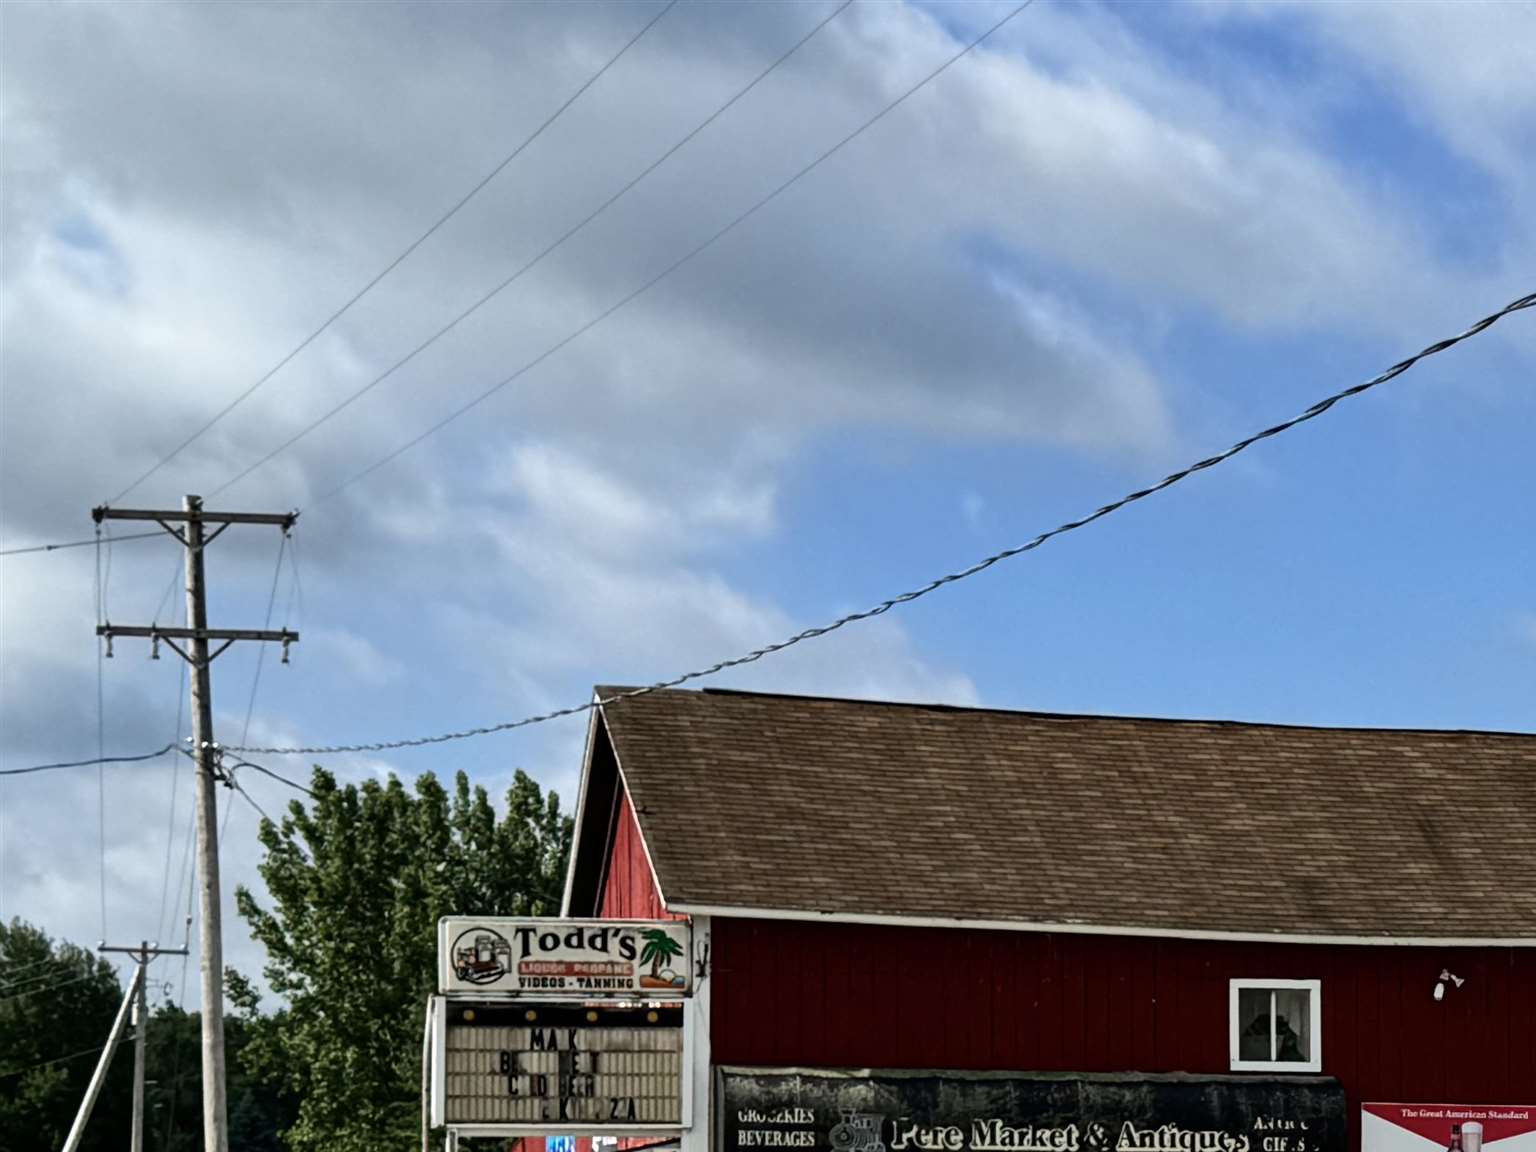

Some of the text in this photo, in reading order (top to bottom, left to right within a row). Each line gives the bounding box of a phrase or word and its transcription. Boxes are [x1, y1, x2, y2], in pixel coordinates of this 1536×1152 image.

[513, 927, 637, 961] Todd's
[519, 977, 565, 988] VIDEOS
[576, 977, 634, 988] TANNING
[1401, 1108, 1529, 1119] The Great American Standard
[737, 1129, 815, 1147] BEVERAGES
[969, 1118, 1080, 1152] Market
[1262, 1136, 1305, 1152] GIFS
